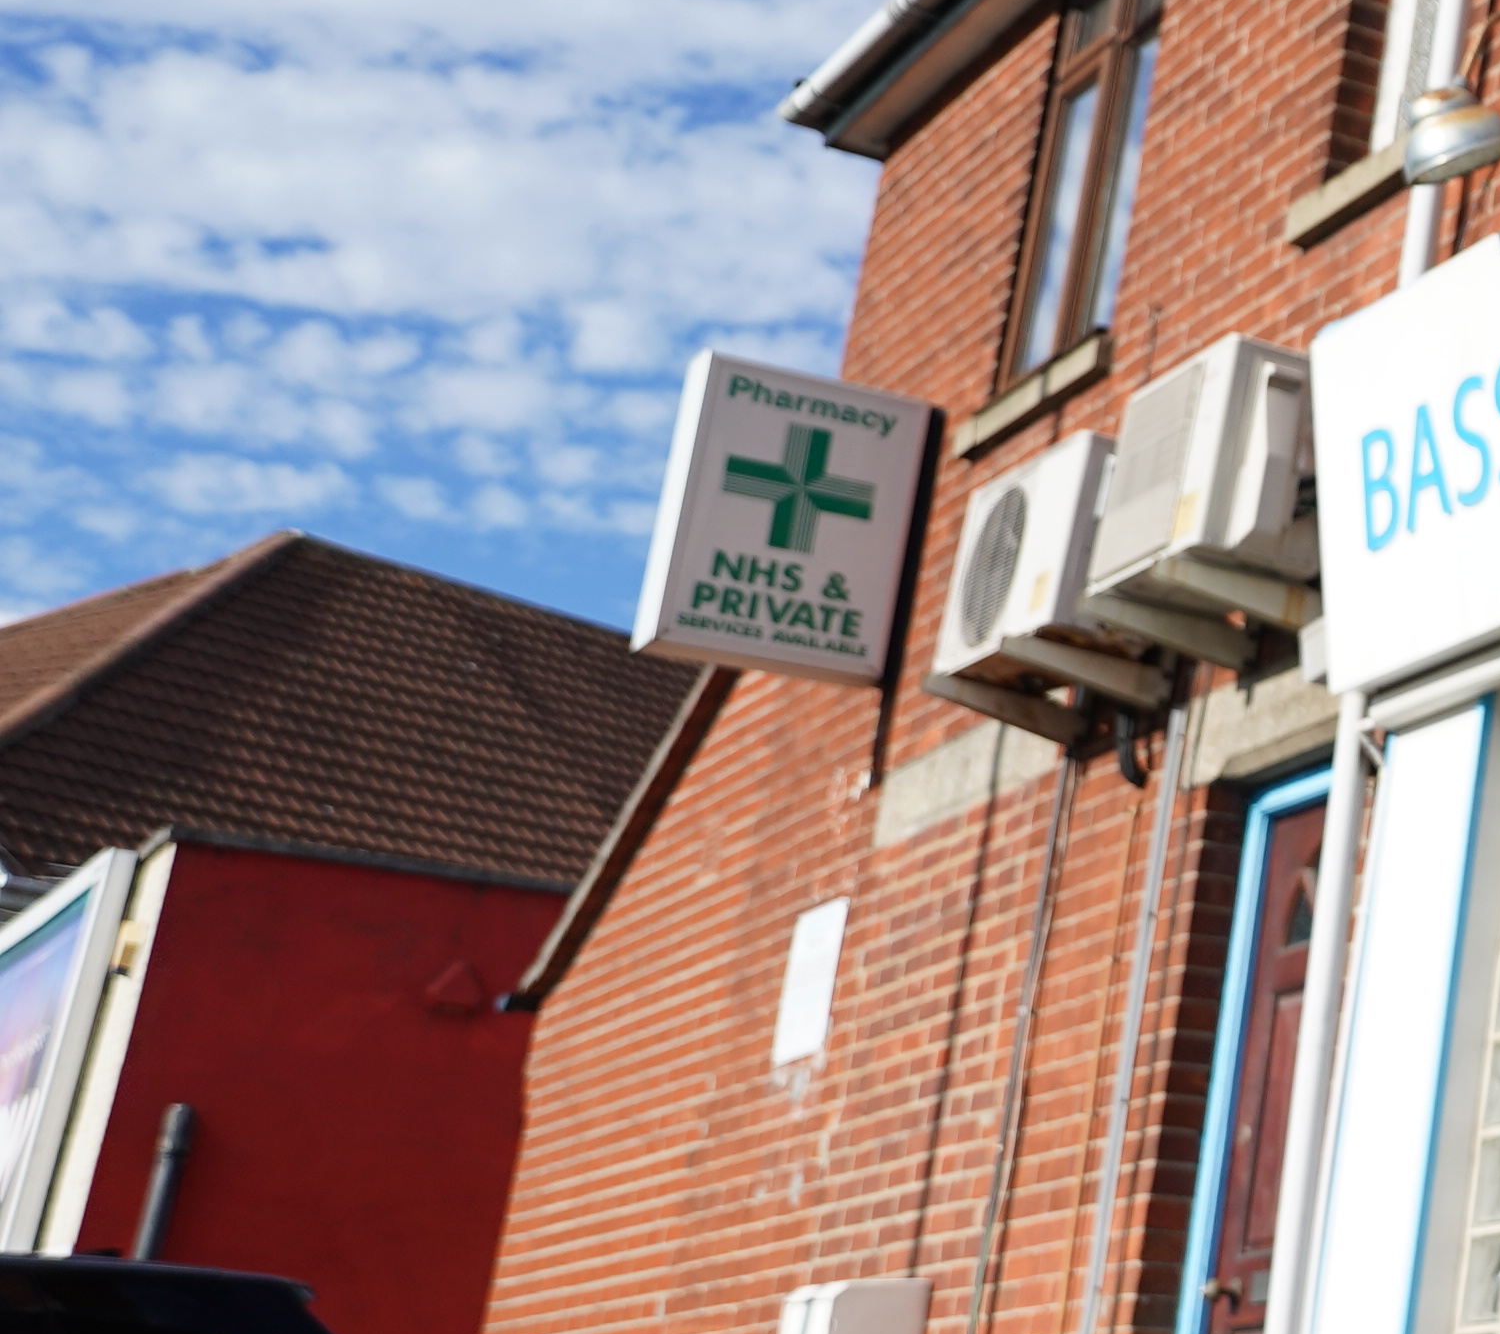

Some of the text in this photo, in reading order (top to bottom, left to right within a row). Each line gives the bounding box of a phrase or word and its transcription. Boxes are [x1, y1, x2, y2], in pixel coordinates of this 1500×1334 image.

[729, 374, 897, 438] Pharmacy
[711, 548, 851, 601] NHS &
[677, 612, 868, 658] SERVICES AVAILABLE
[691, 582, 862, 637] PRIVATE
